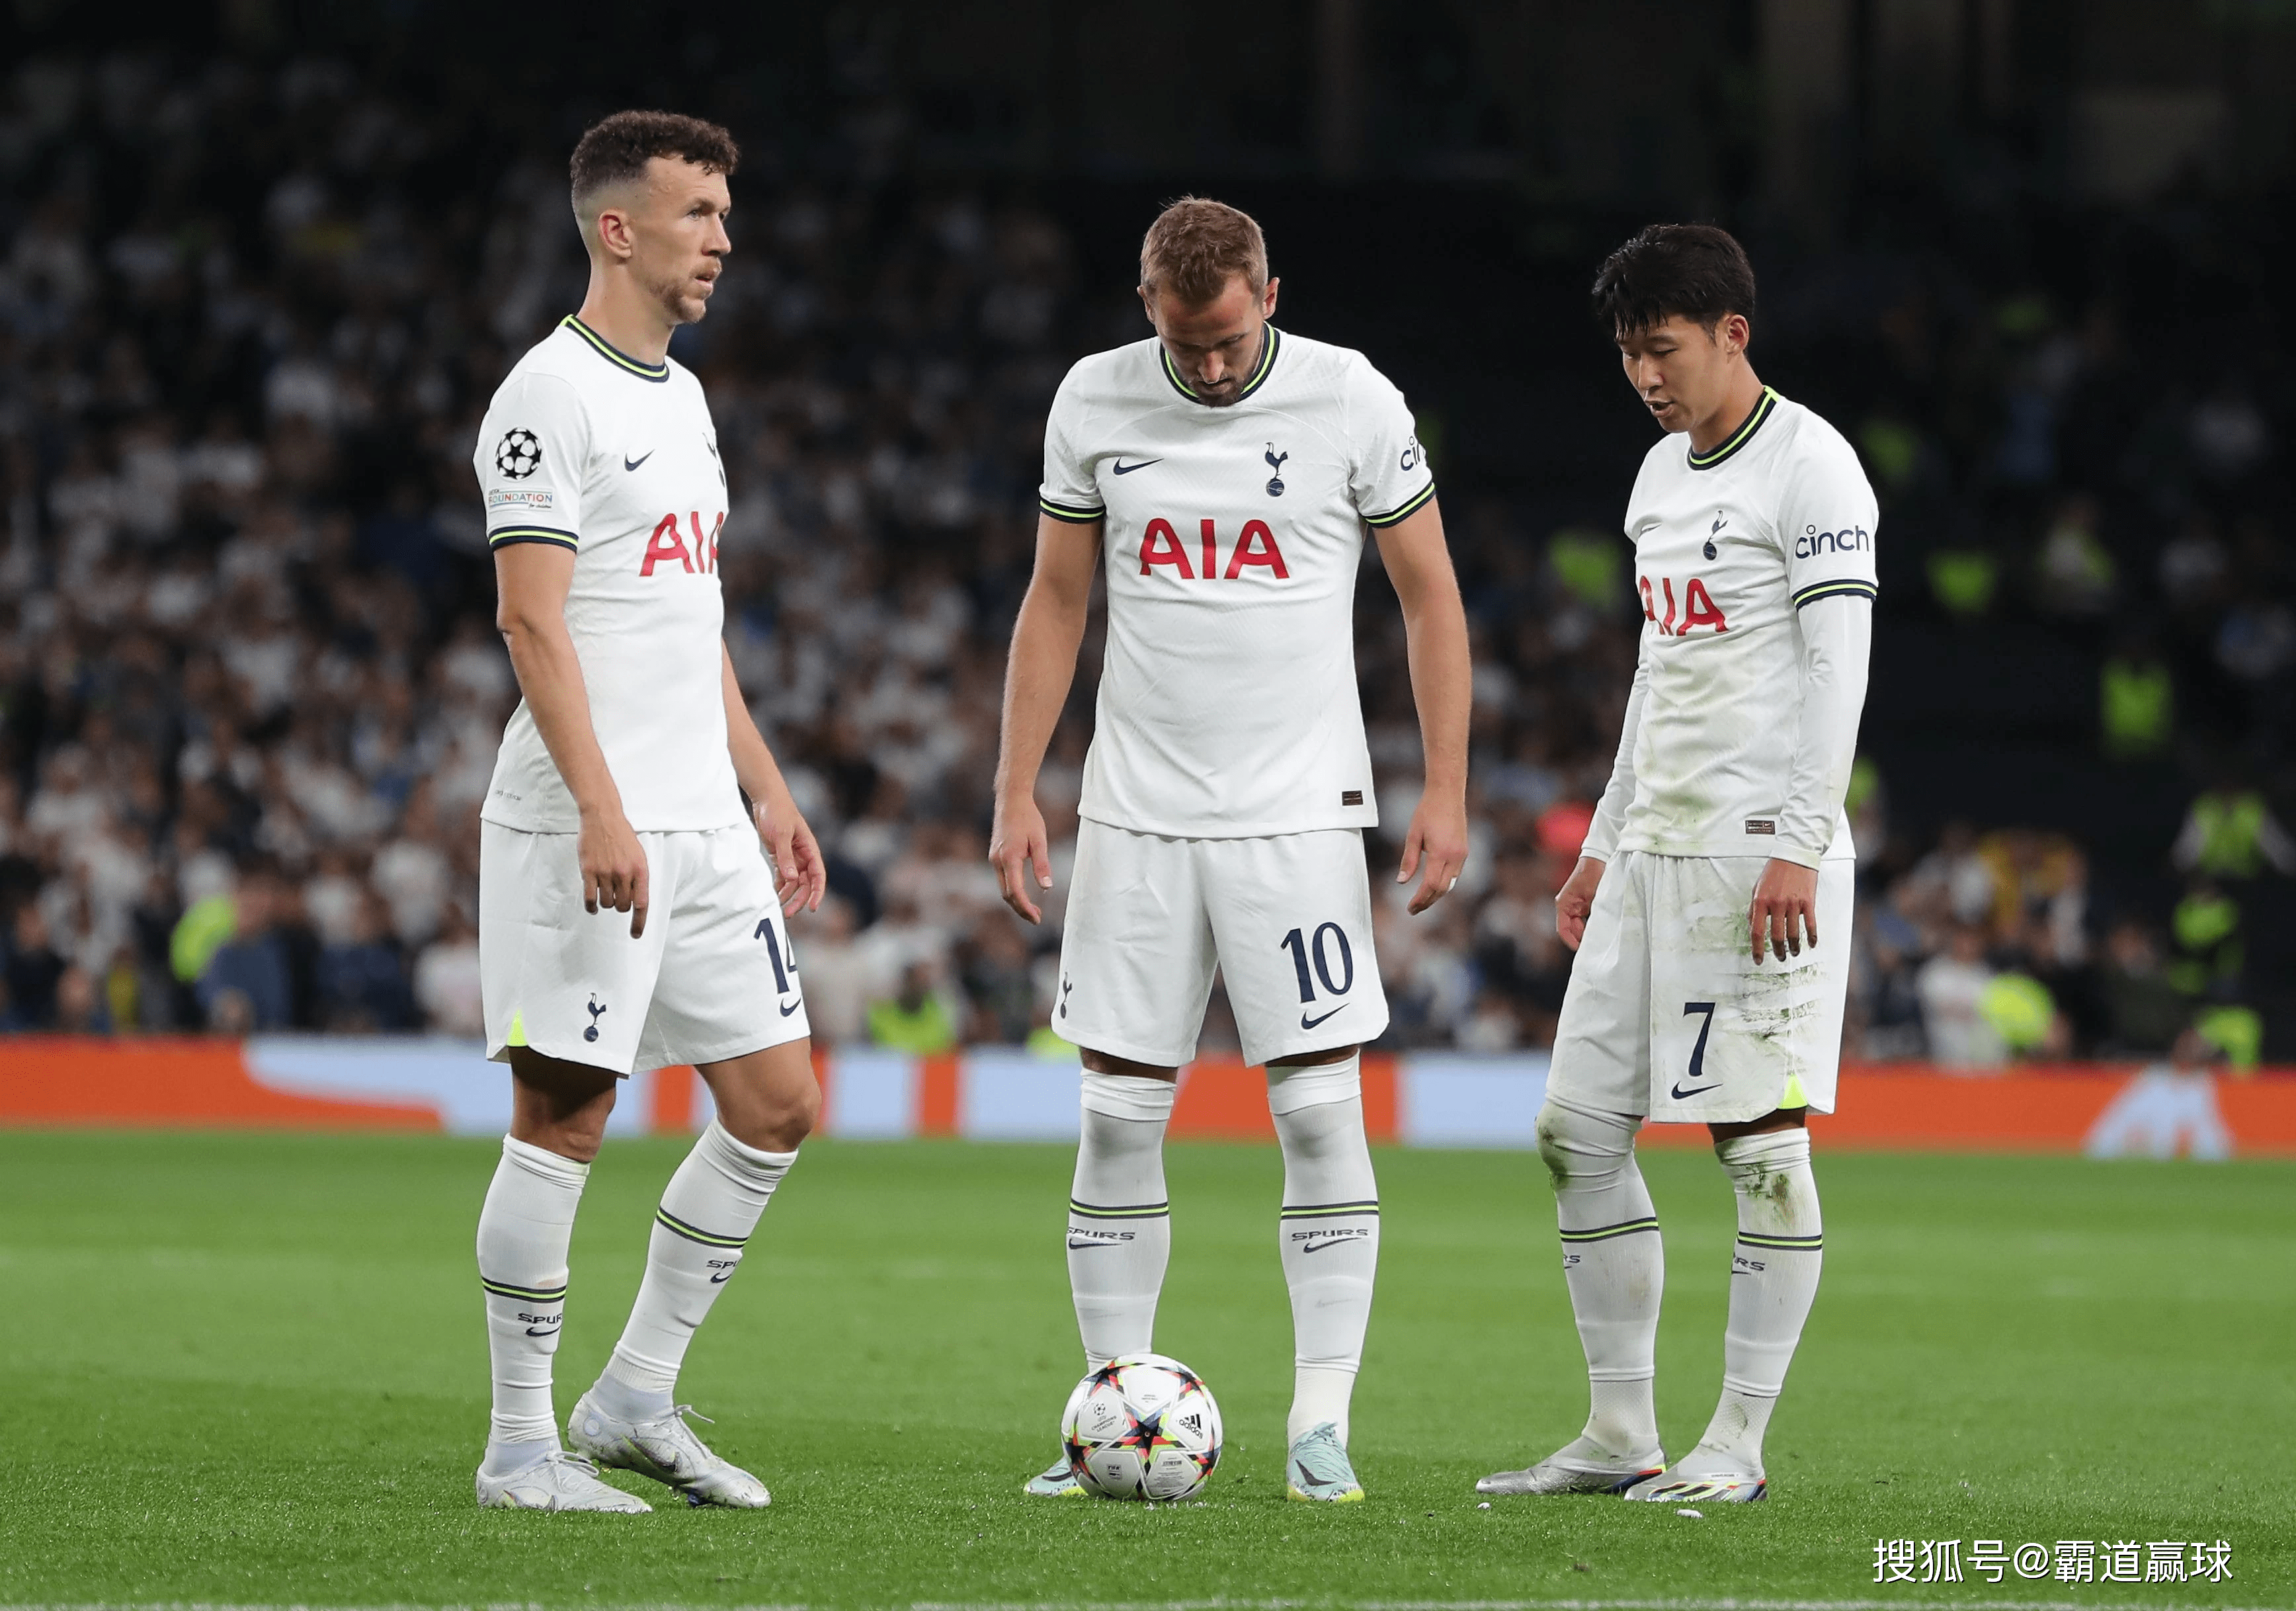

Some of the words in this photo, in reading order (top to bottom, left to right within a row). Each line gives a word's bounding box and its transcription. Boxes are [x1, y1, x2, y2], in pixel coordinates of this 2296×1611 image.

[489, 493, 553, 504] FOUNDATION
[1139, 518, 1290, 579] AIA
[1795, 524, 1869, 559] cinch
[1639, 575, 1729, 636] AIA
[1280, 921, 1354, 1004] 10
[1683, 1002, 1716, 1077] 7
[1292, 1228, 1369, 1241] SPURS
[1179, 1419, 1203, 1439] adidas
